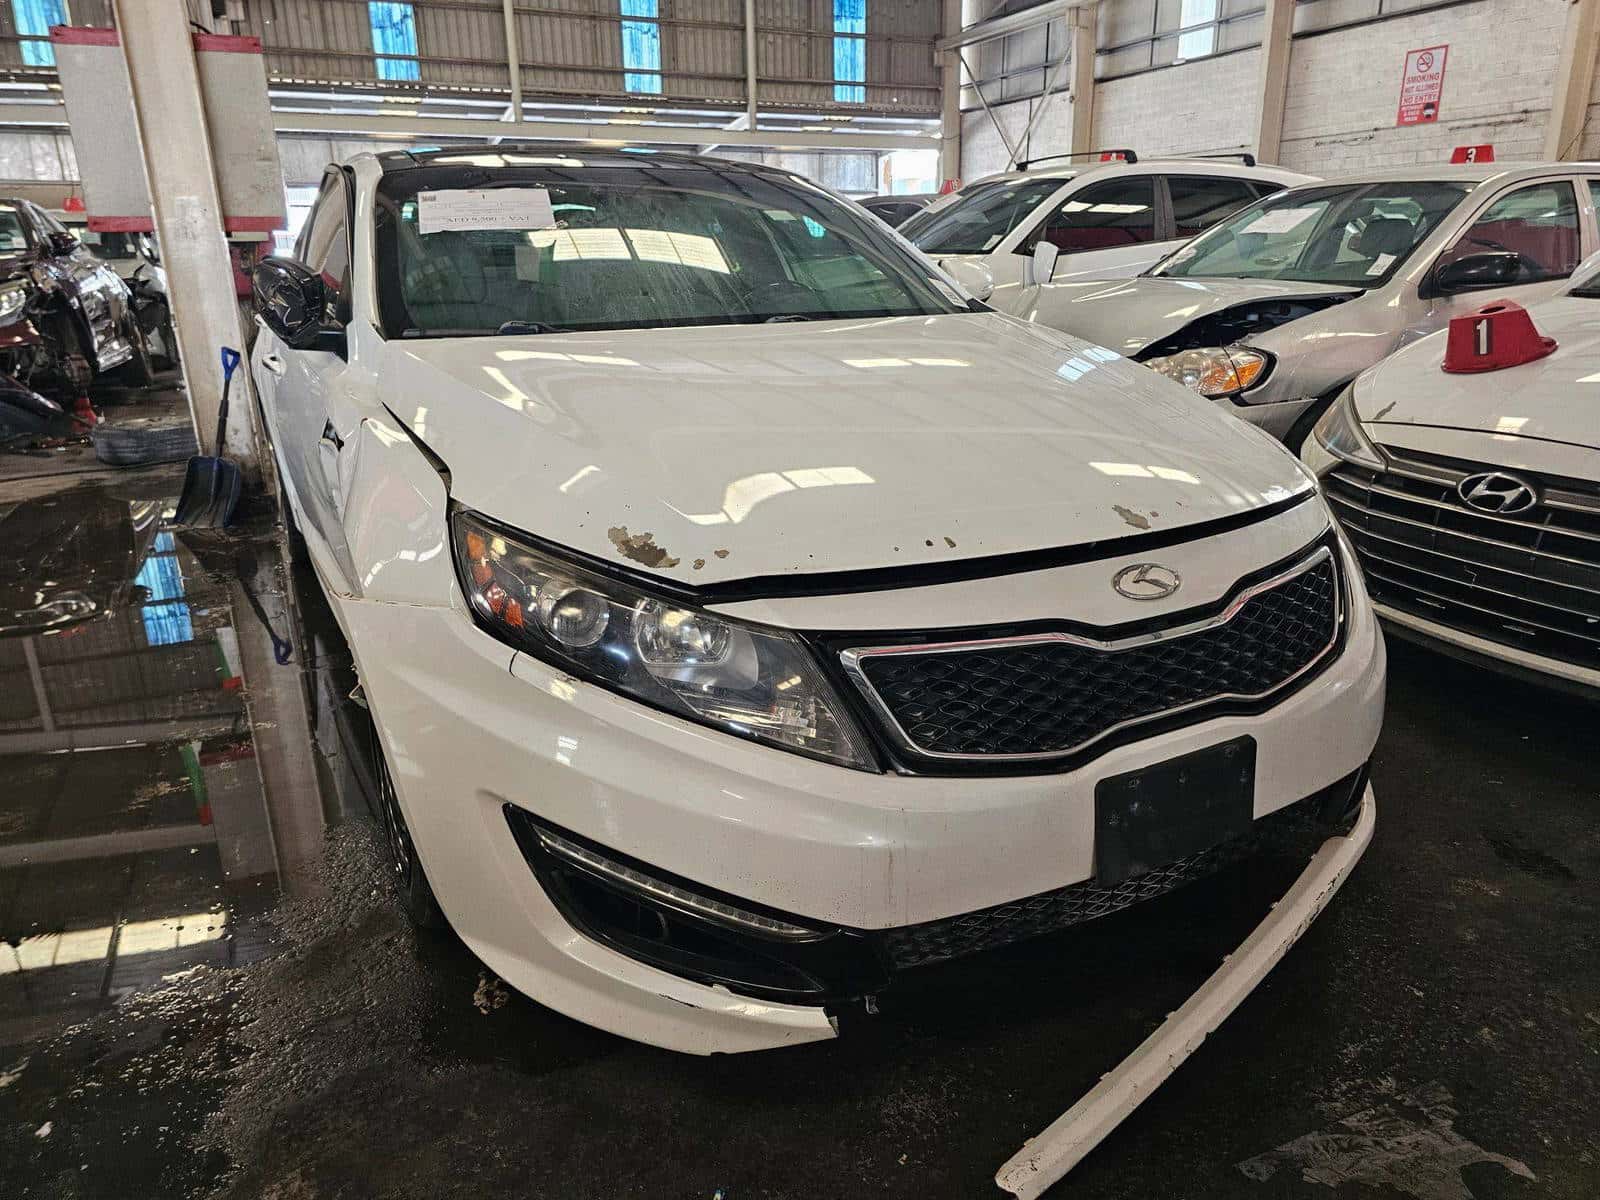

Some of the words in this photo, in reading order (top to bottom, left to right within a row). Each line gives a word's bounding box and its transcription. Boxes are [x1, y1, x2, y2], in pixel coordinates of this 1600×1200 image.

[1406, 72, 1440, 83] SMOKING
[1403, 96, 1413, 104] NO
[1415, 93, 1437, 102] ENTRY
[1466, 148, 1476, 162] 3
[1476, 319, 1488, 355] 1
